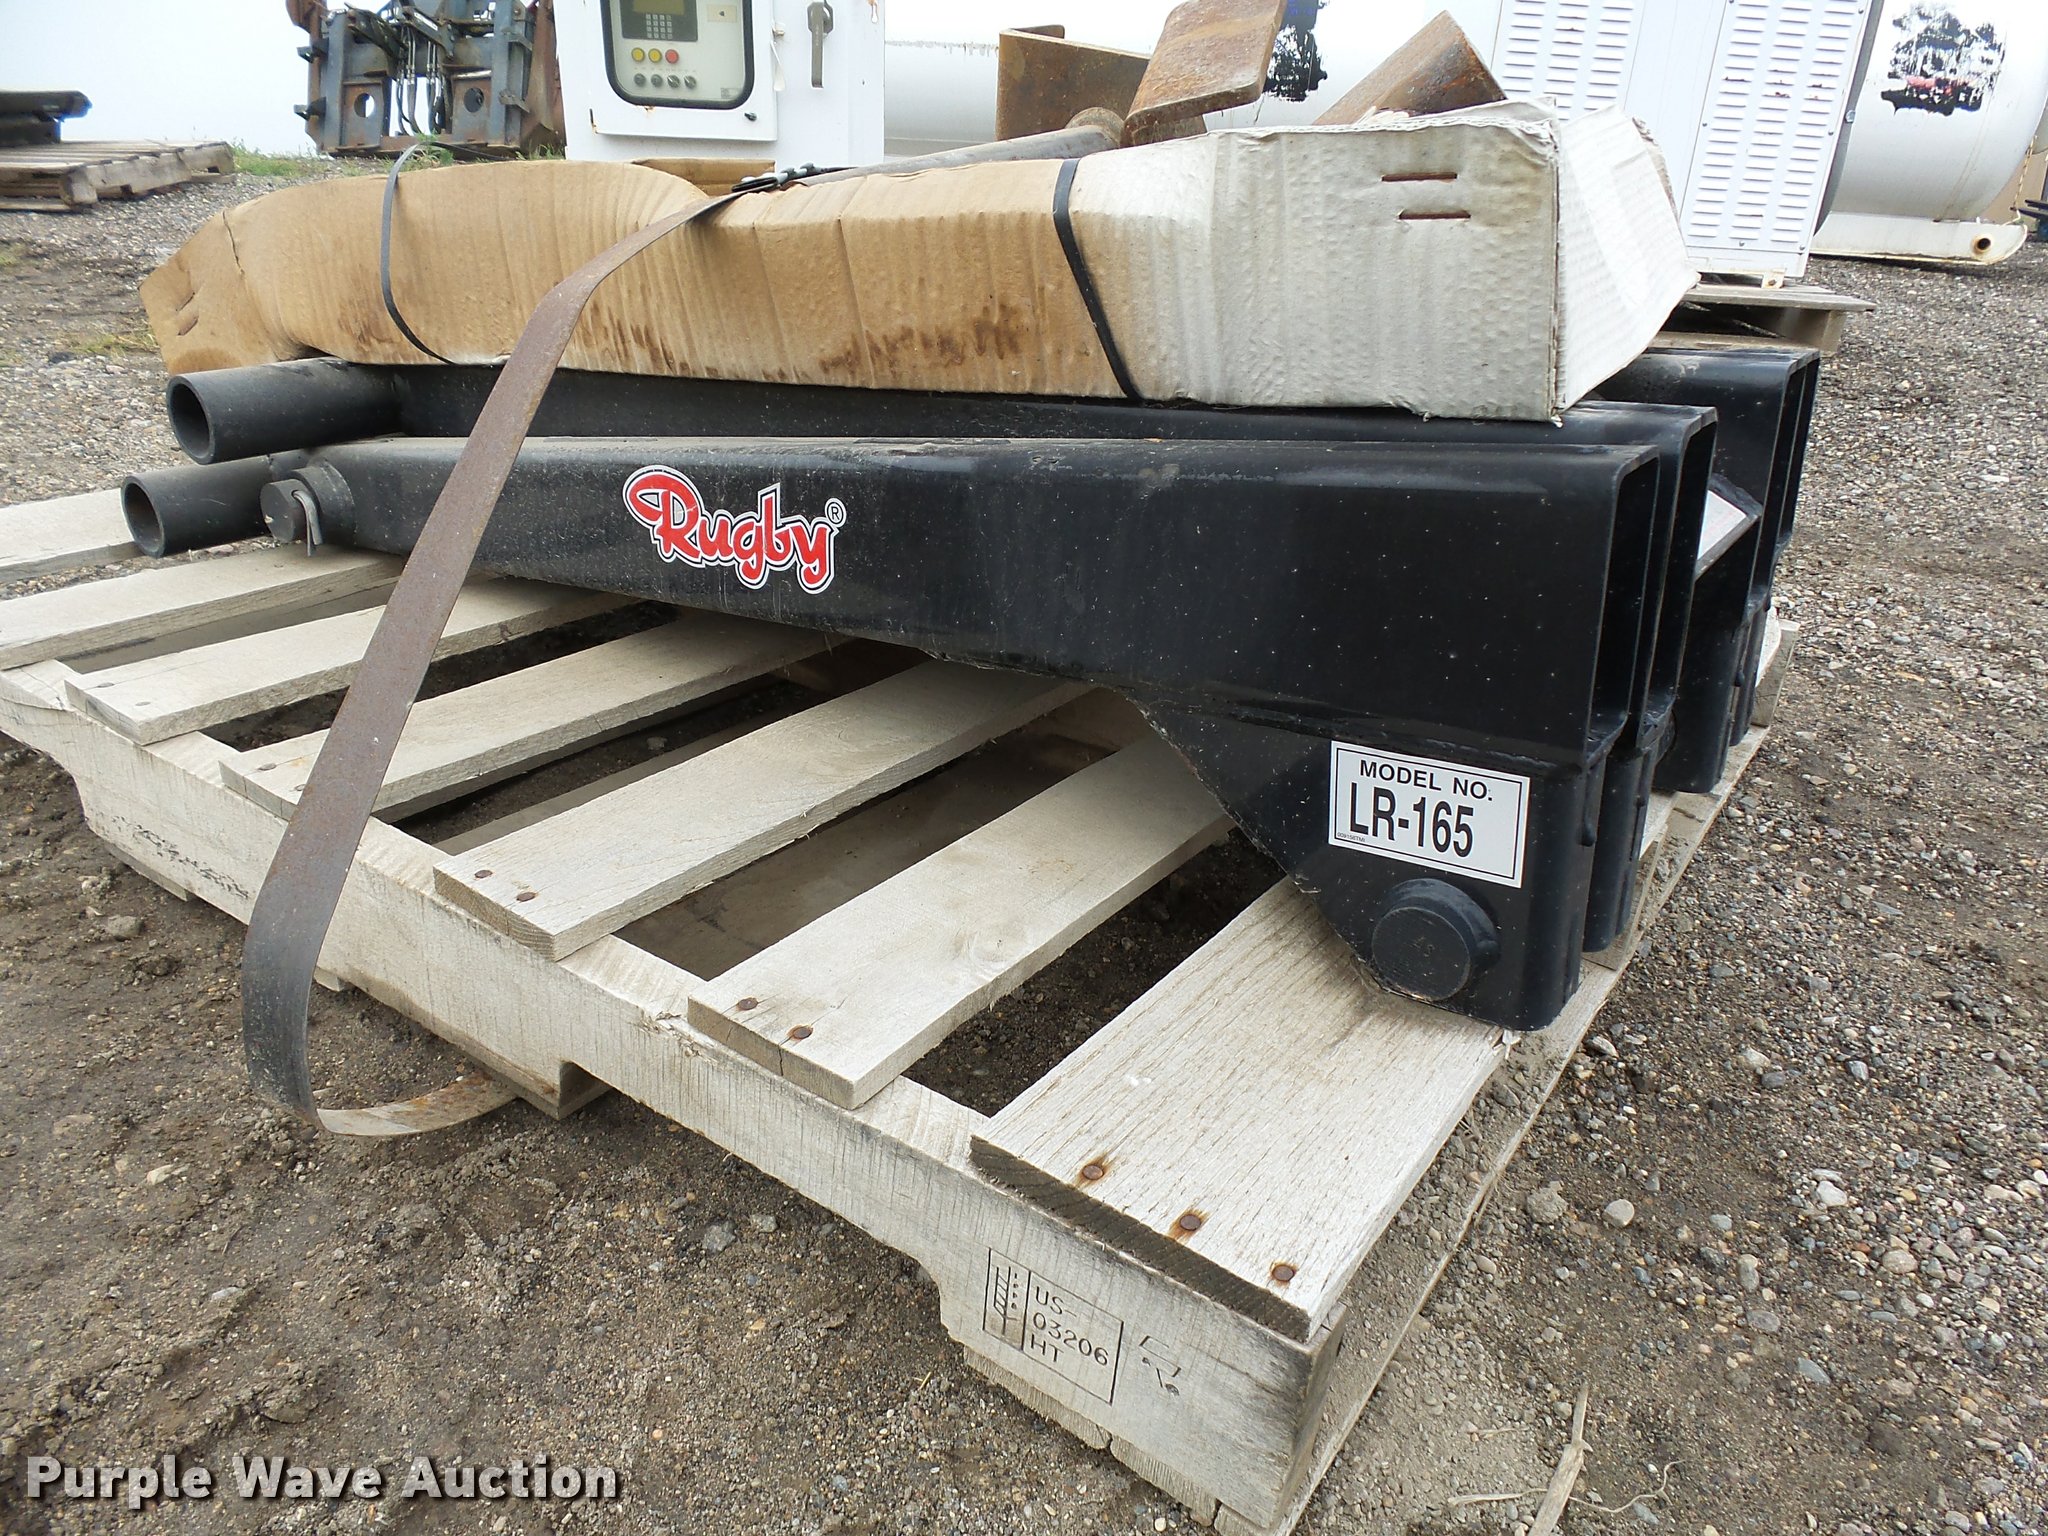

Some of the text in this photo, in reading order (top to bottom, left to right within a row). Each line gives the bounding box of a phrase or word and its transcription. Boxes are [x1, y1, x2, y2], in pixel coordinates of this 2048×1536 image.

[1360, 760, 1493, 802] MODEL NO.
[1350, 782, 1474, 857] LR-165
[1030, 1333, 1064, 1363] HT
[1034, 1312, 1109, 1366] 03206
